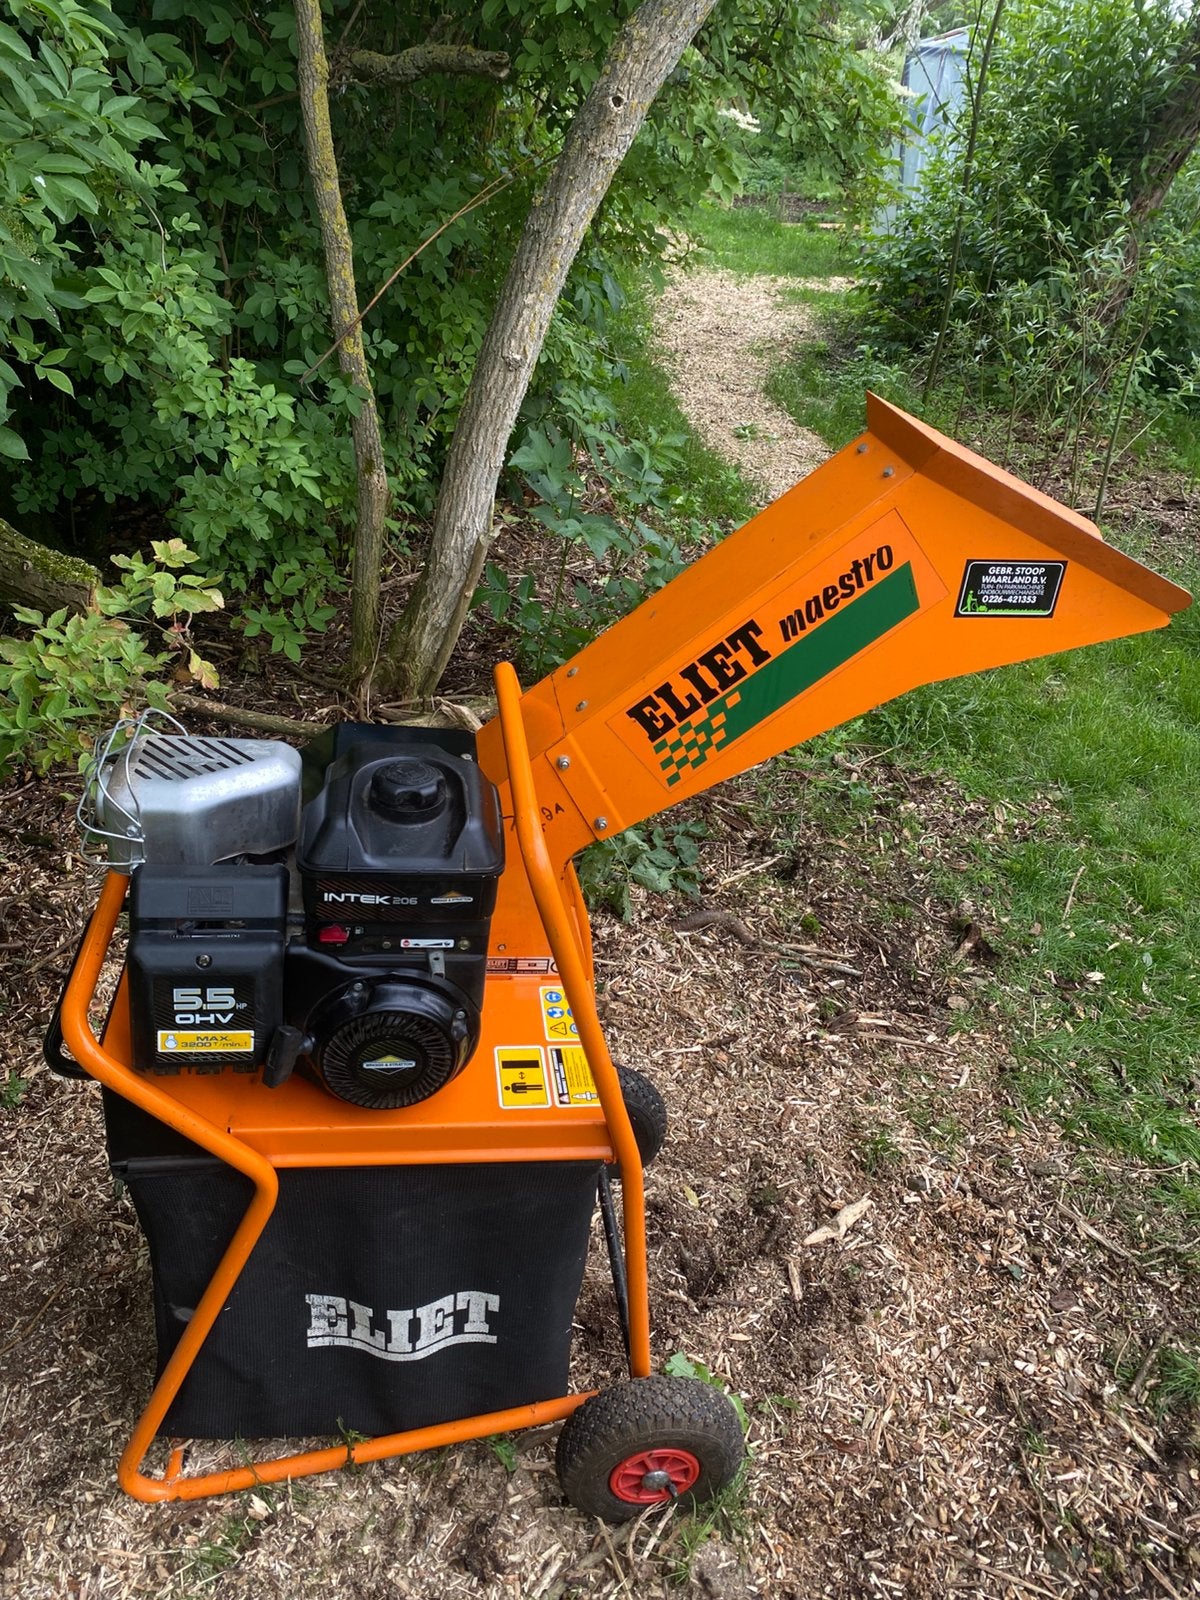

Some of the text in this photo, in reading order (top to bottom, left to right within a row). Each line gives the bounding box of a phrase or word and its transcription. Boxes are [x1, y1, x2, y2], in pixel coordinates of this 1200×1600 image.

[988, 566, 1046, 576] GEBR. STOOP
[982, 575, 1047, 584] WAARLAND B.V.
[982, 595, 1037, 604] 0226-421353
[625, 545, 893, 743] ELIET maestro
[323, 892, 391, 905] INTEK
[392, 896, 418, 905] 206
[173, 988, 248, 1011] 5.5 HP
[175, 1013, 235, 1024] OHV
[305, 1291, 500, 1353] ELIET
